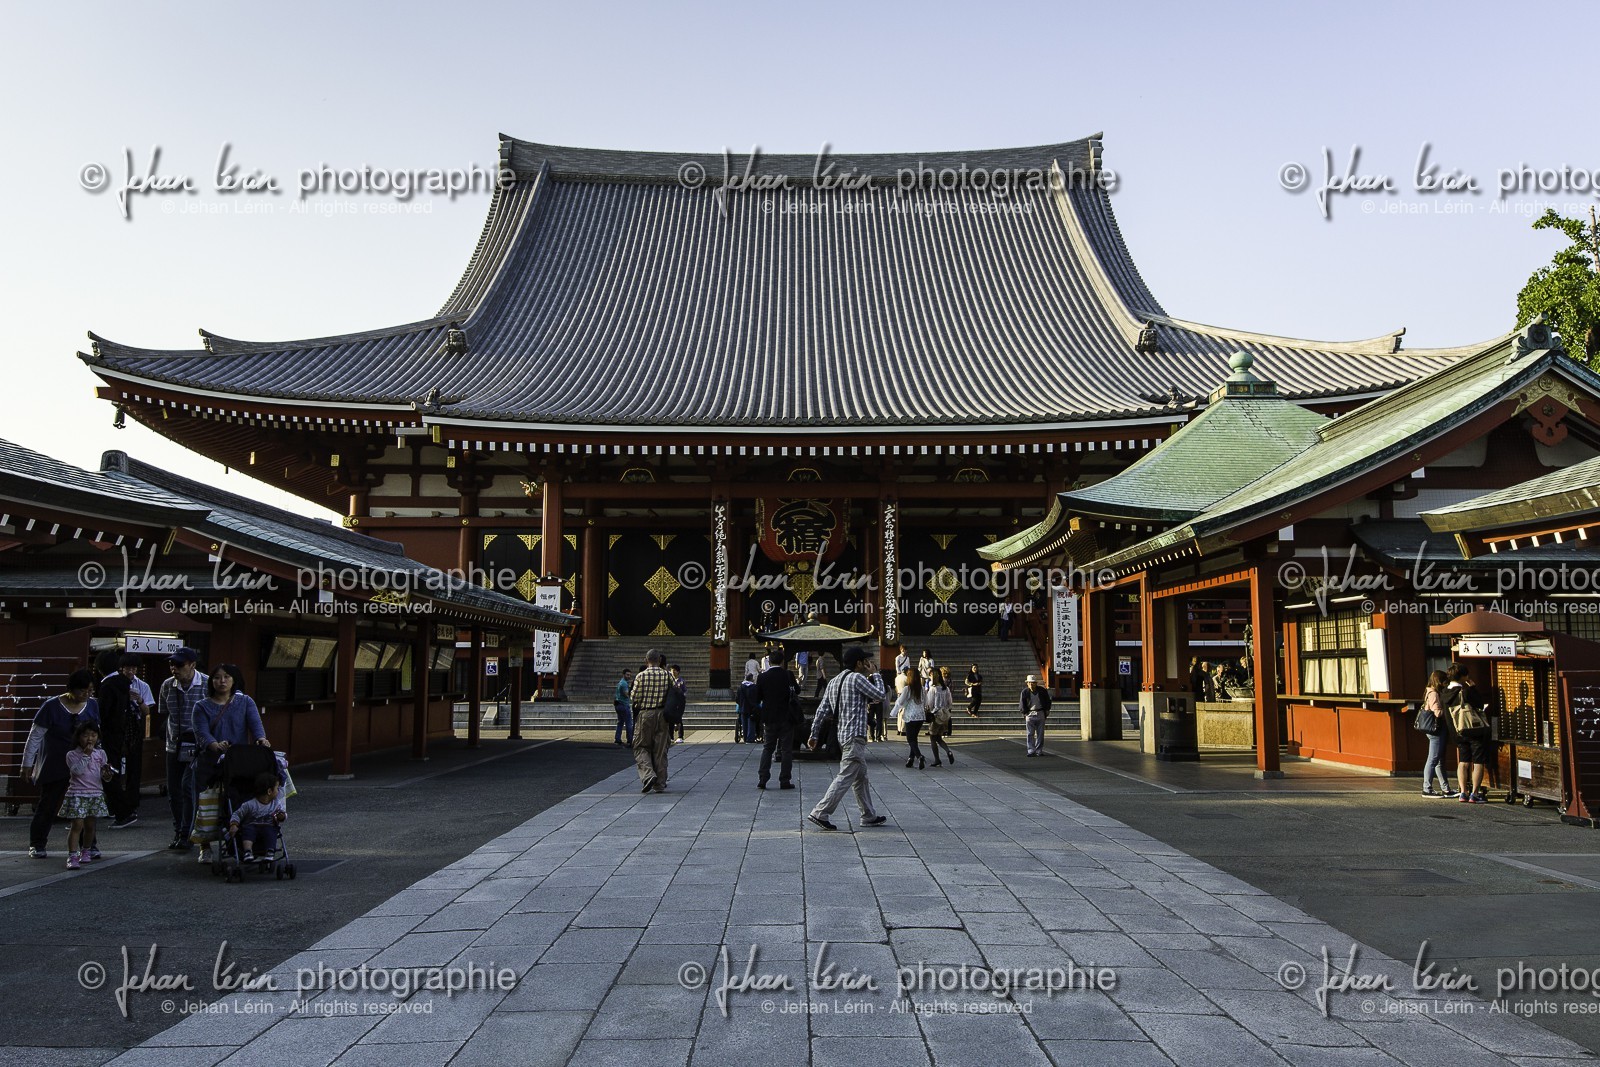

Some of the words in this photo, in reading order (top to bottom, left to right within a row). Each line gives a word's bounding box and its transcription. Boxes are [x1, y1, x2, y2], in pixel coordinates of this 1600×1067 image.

[132, 639, 163, 651] みくじ
[1463, 642, 1493, 655] みくじ
[1497, 646, 1512, 655] 100円
